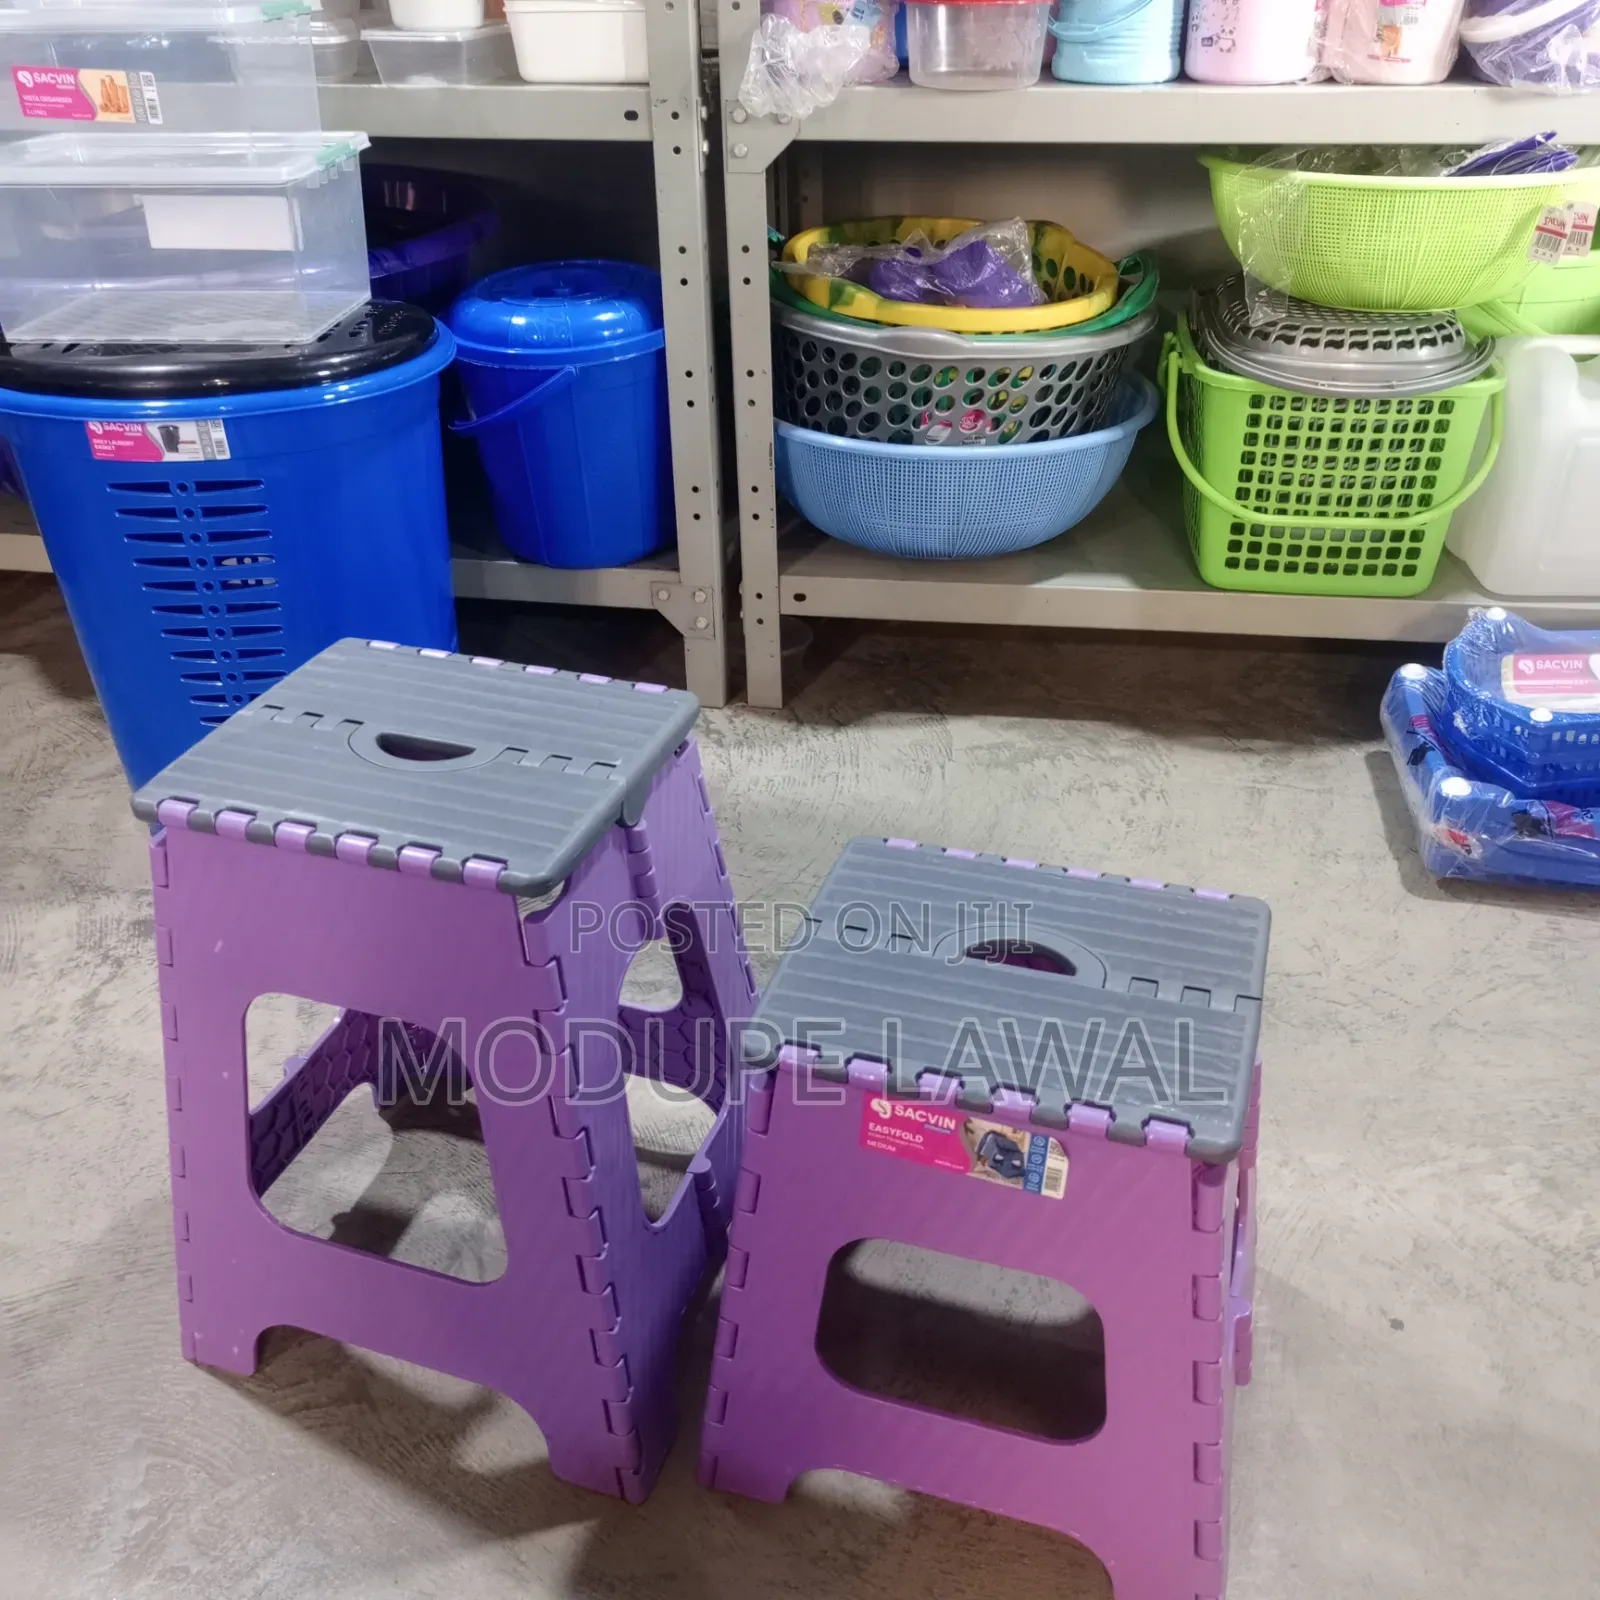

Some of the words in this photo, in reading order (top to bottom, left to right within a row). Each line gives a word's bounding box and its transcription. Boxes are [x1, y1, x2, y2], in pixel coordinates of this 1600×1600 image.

[33, 72, 76, 85] SACVIN
[103, 422, 143, 432] SACVIN
[1535, 660, 1583, 669] SACVIN
[894, 1104, 956, 1130] SACVIN
[868, 1122, 924, 1143] EASYFOLD
[866, 1139, 897, 1152] MEDIUM
